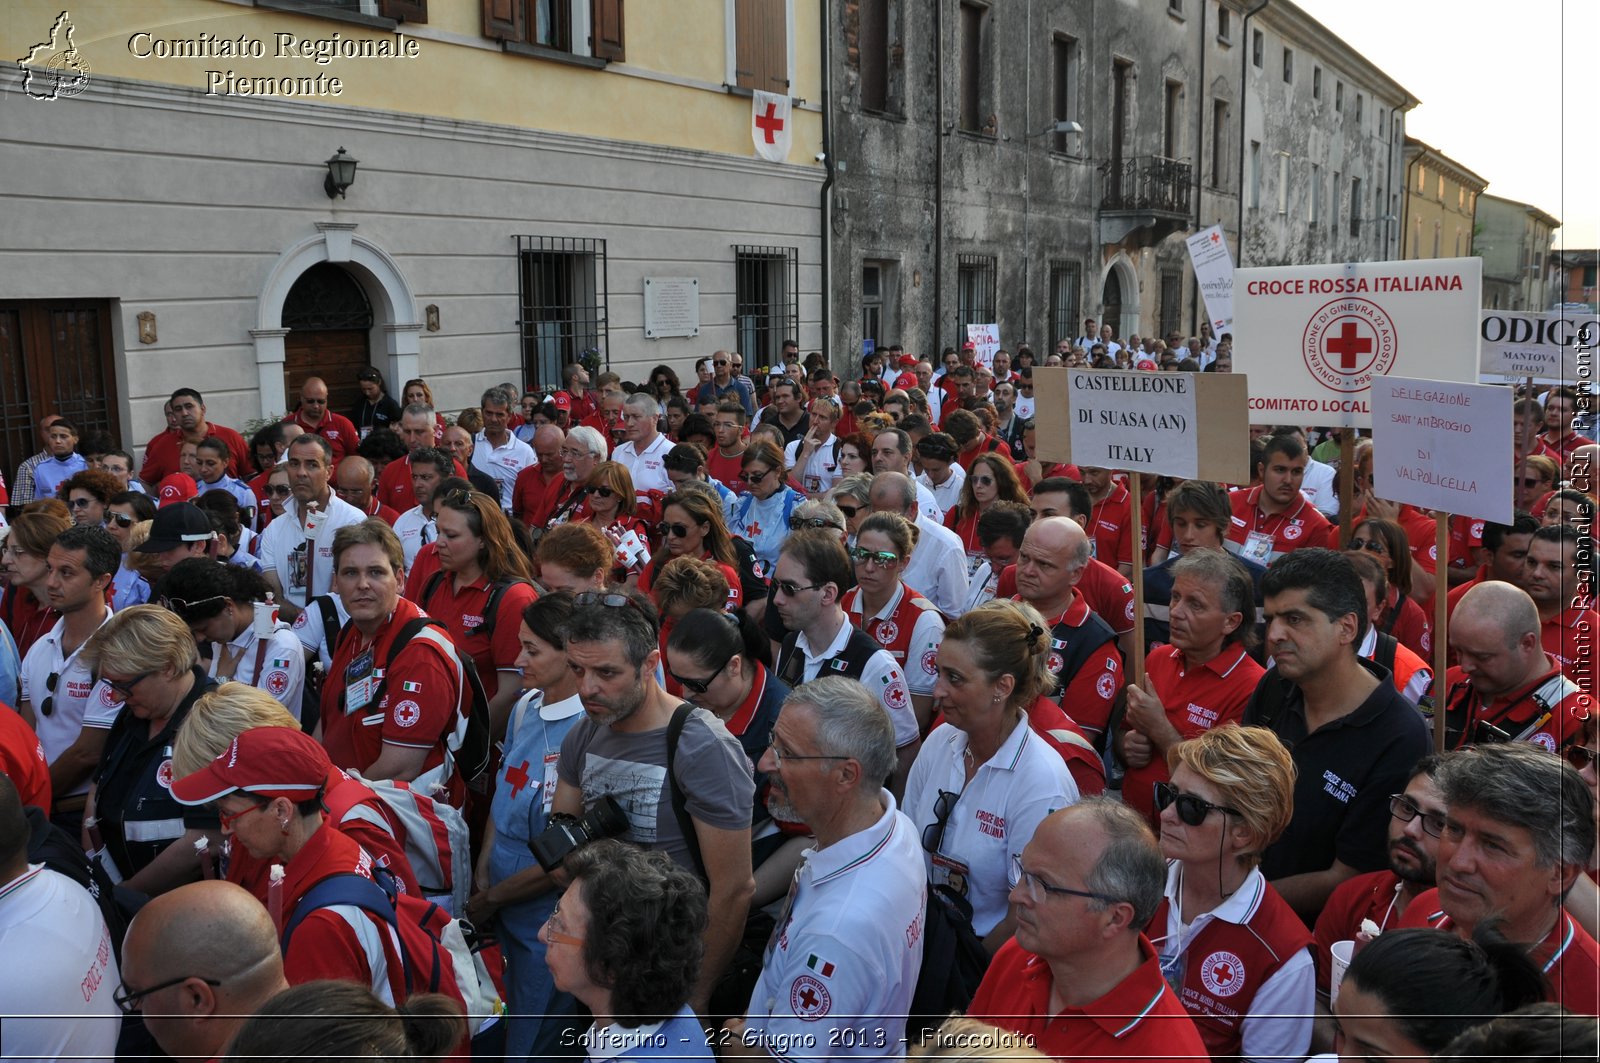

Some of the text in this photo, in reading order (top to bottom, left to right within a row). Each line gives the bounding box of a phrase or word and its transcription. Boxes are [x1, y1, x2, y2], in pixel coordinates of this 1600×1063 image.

[1248, 280, 1305, 296] CROCE
[1309, 278, 1369, 294] ROSSA
[1374, 275, 1463, 292] ITALIANA
[1308, 303, 1391, 386] CONVENZIONE DI GINEVRA 22 AGOSTO 864
[1503, 351, 1556, 363] MANTOVA
[1512, 363, 1545, 374] (ITALY)
[1075, 375, 1187, 394] CASTELLEONE
[1248, 398, 1319, 411] COMITATO
[1392, 387, 1471, 407] DELEGAZIONE
[1078, 408, 1187, 434] DI SUASA (AN)
[1108, 444, 1155, 463] ITALY
[1417, 449, 1431, 460] DI
[1396, 465, 1477, 494] VALPOLICELLA
